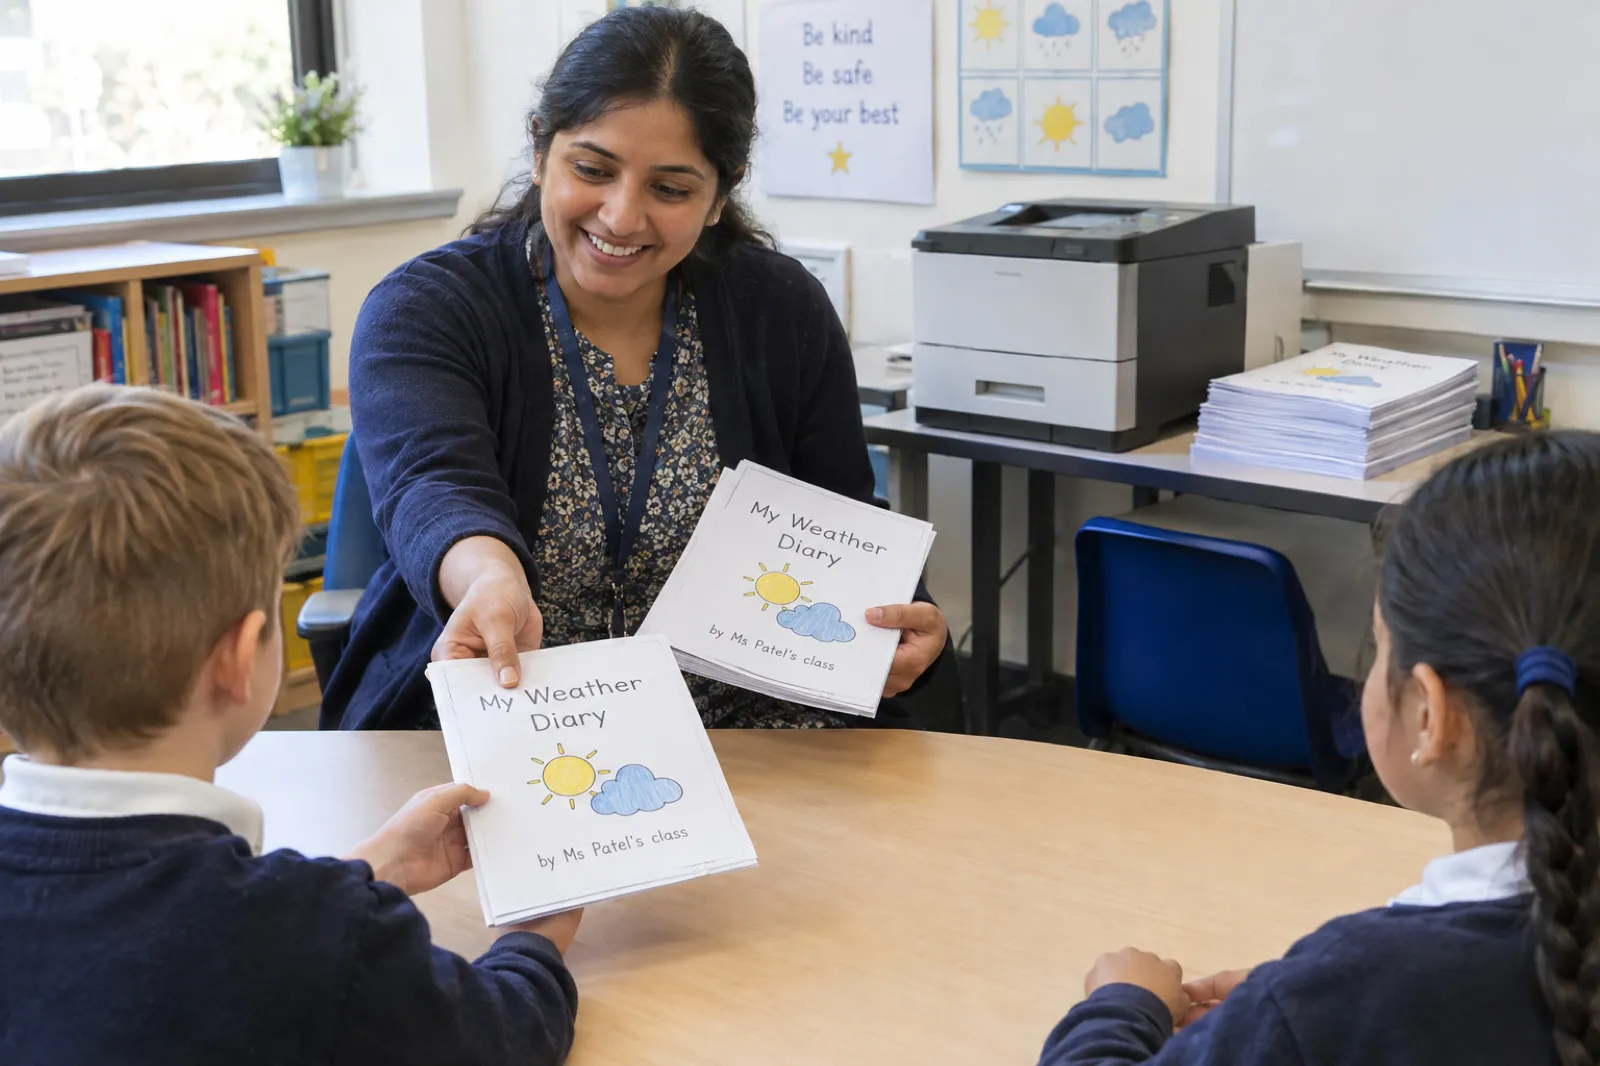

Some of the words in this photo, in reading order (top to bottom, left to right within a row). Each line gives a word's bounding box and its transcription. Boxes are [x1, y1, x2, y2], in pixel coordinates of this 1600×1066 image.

[803, 22, 824, 46] Be
[832, 19, 873, 45] kind
[803, 60, 824, 85] Be
[832, 59, 872, 85] safe
[783, 100, 804, 124] Be
[811, 108, 852, 132] your
[859, 99, 899, 125] best
[750, 500, 781, 525] My
[791, 513, 887, 555] Weather
[777, 533, 842, 568] Diary
[708, 624, 725, 640] by
[730, 631, 748, 647] Ms
[754, 639, 797, 661] Patel's
[803, 655, 836, 672] class
[479, 694, 514, 713] My
[524, 677, 643, 705] Weather
[530, 709, 606, 732] Diary
[537, 853, 555, 871] by
[563, 847, 585, 863] Ms
[591, 836, 645, 857] Patel's
[651, 827, 689, 844] class
